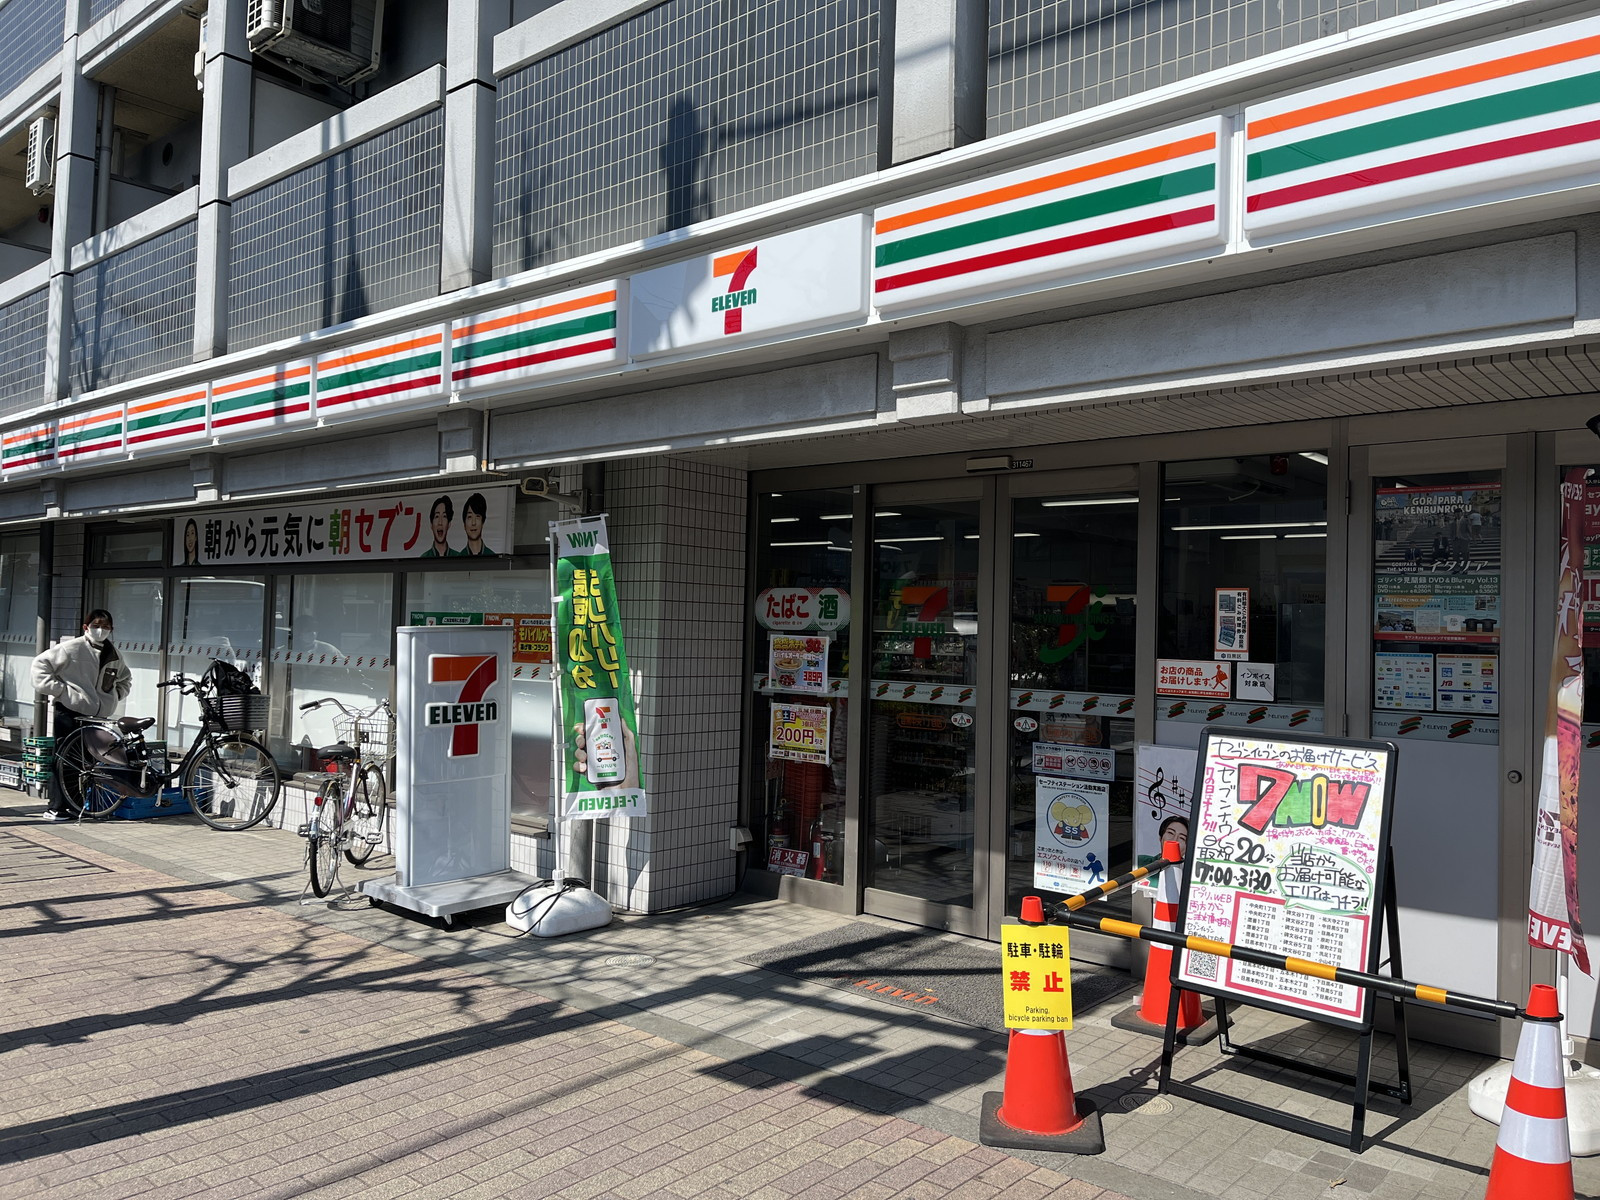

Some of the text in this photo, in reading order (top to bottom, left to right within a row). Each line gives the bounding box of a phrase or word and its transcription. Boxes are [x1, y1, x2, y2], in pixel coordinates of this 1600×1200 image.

[1012, 460, 1032, 469] 311467
[1412, 495, 1464, 506] GORIPARA
[1403, 504, 1473, 515] KENBUNROKU
[204, 501, 422, 560] 朝から元気に朝セブン
[1429, 559, 1489, 573] イタリア
[766, 594, 838, 619] たばこ 酒
[1160, 666, 1203, 677] お店の商品
[1241, 672, 1270, 680] インボイス
[1244, 680, 1266, 688] 対象店
[1211, 739, 1380, 770] セブンイレブンのお届けサービス
[1217, 767, 1237, 836] セブンナウ
[1237, 763, 1372, 836] 7NOW
[1064, 826, 1078, 835] SS
[771, 849, 807, 865] 消火器
[1290, 844, 1336, 867] 当店から
[1276, 866, 1368, 891] お届け可能な
[1190, 900, 1225, 915] 両方から
[1249, 902, 1277, 912] 中央町1丁目
[1248, 910, 1276, 920] 中央町2丁目
[1007, 942, 1064, 959] 駐車・駐輪
[1009, 970, 1065, 992] 禁止
[1008, 1014, 1030, 1022] bicycle
[1031, 1015, 1055, 1023] parking
